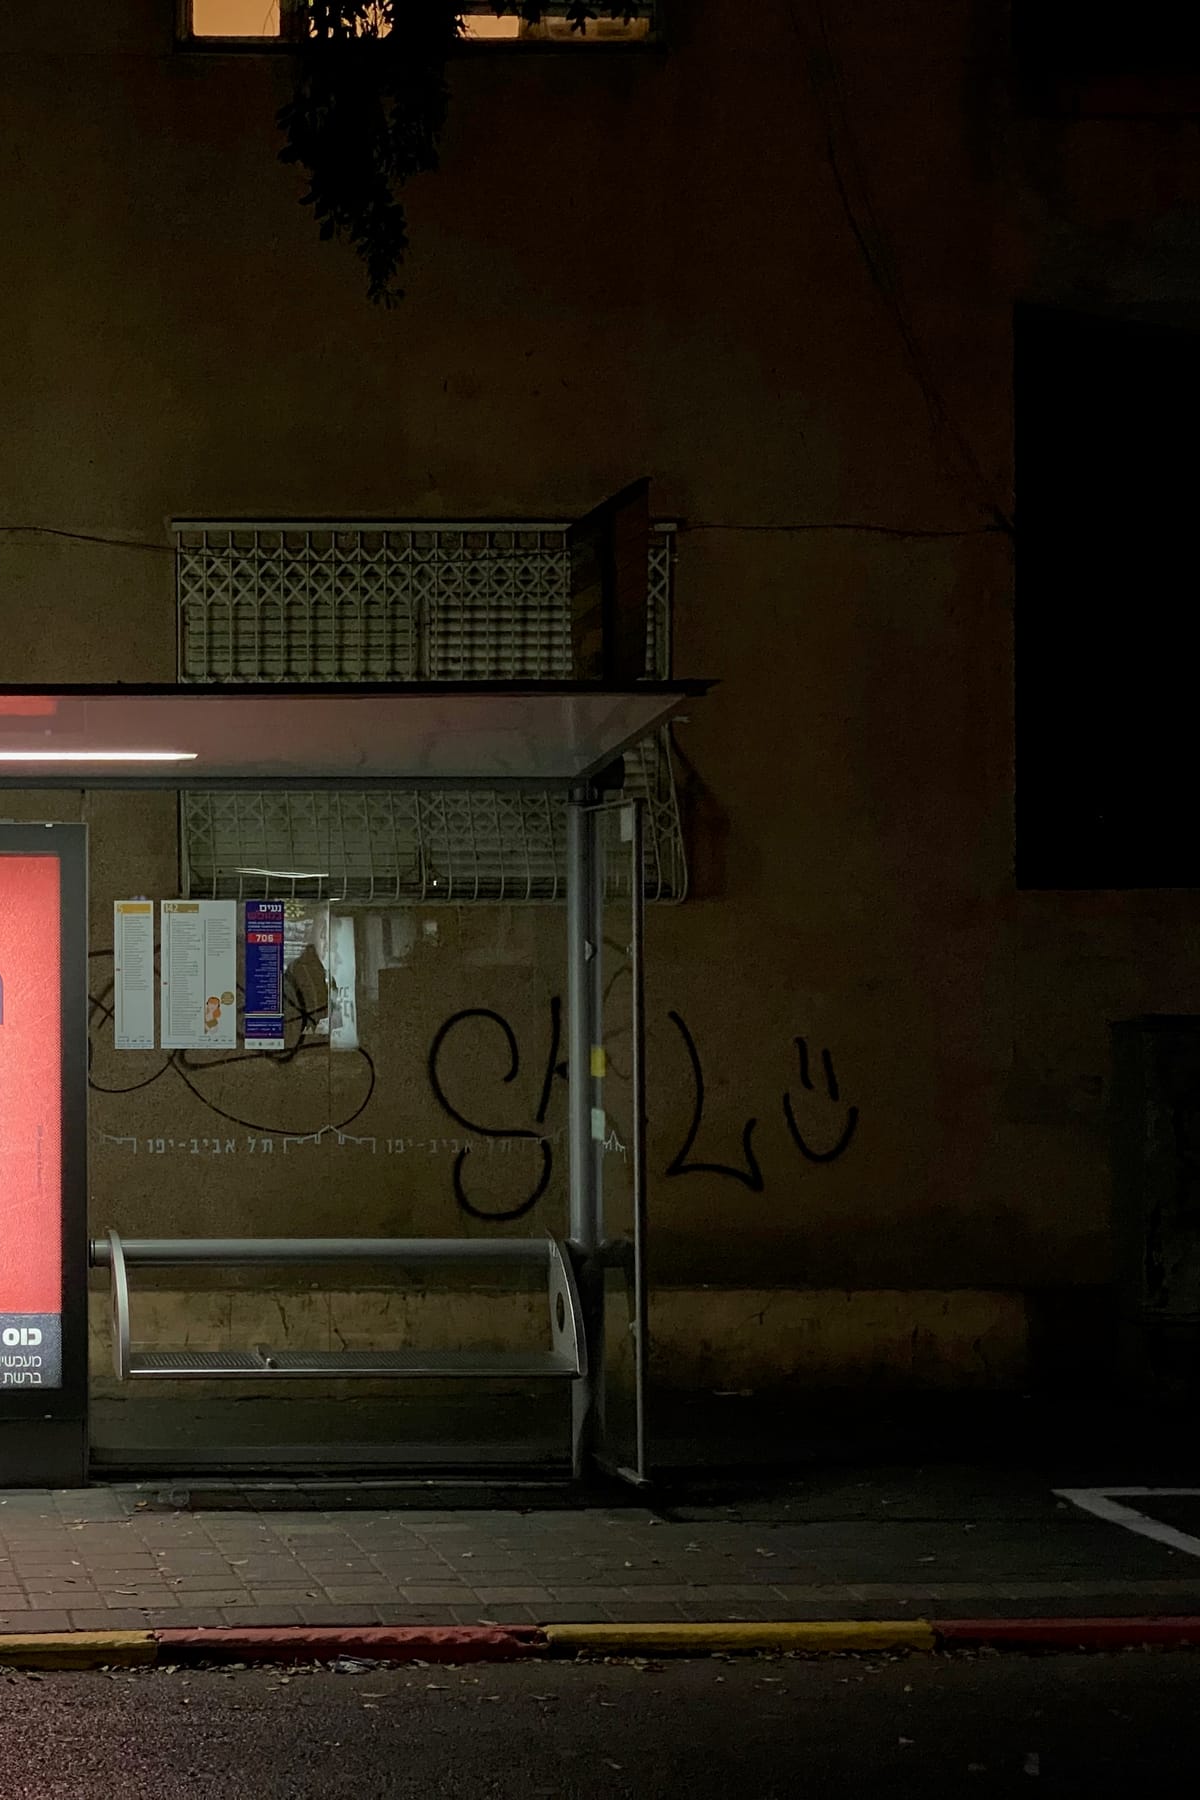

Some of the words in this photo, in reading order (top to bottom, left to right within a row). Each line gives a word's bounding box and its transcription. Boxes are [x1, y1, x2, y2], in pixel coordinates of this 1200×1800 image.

[246, 1136, 274, 1154] תל
[2, 1327, 42, 1347] כוס
[2, 1372, 42, 1384] ברשת
